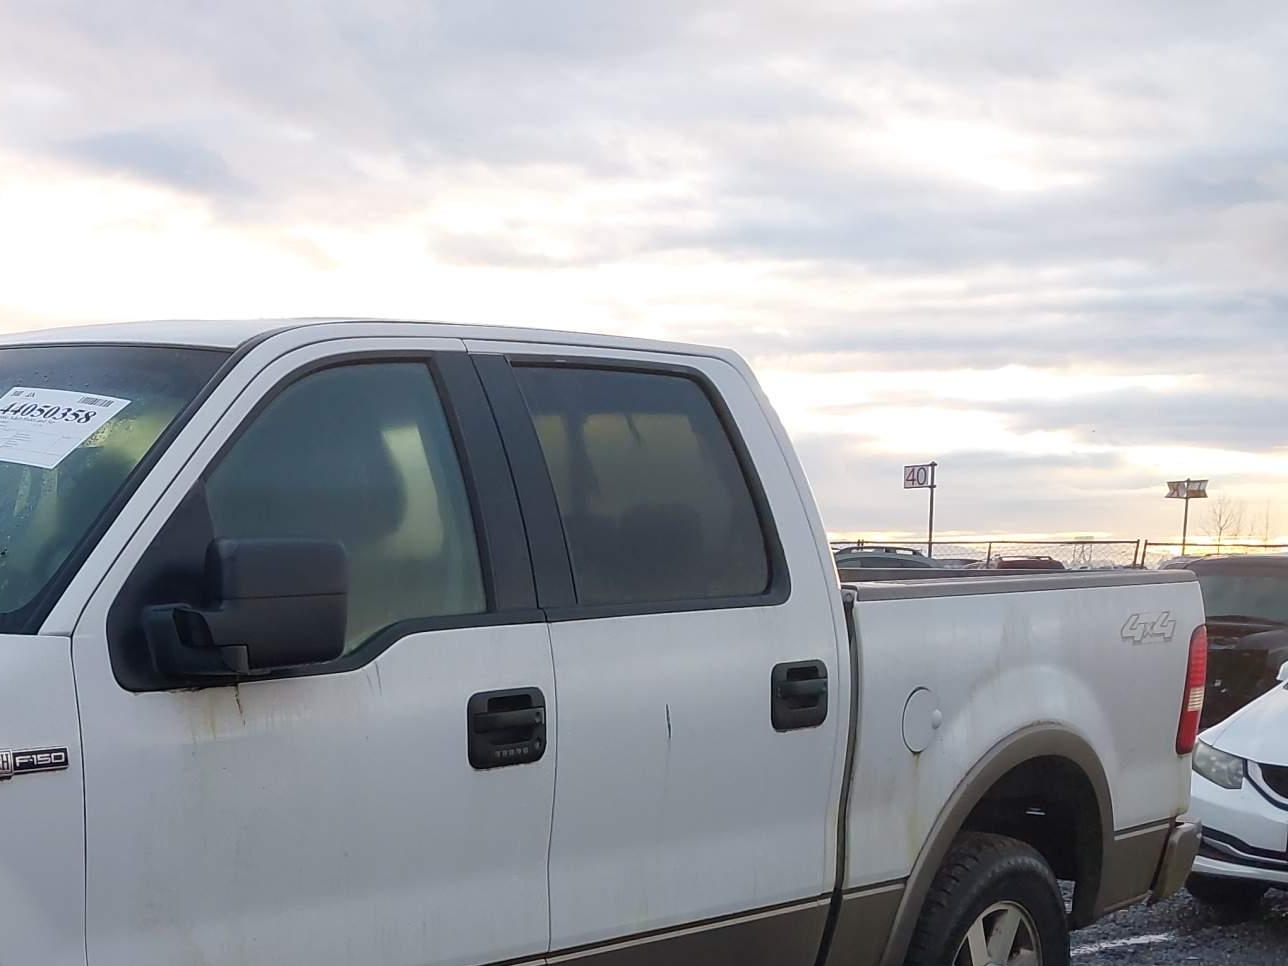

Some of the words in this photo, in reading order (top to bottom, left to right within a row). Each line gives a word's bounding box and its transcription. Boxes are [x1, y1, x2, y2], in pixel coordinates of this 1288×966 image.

[0, 402, 98, 424] 44050358
[905, 467, 927, 486] 40
[1121, 611, 1177, 644] 4x4
[15, 752, 65, 768] F-150
